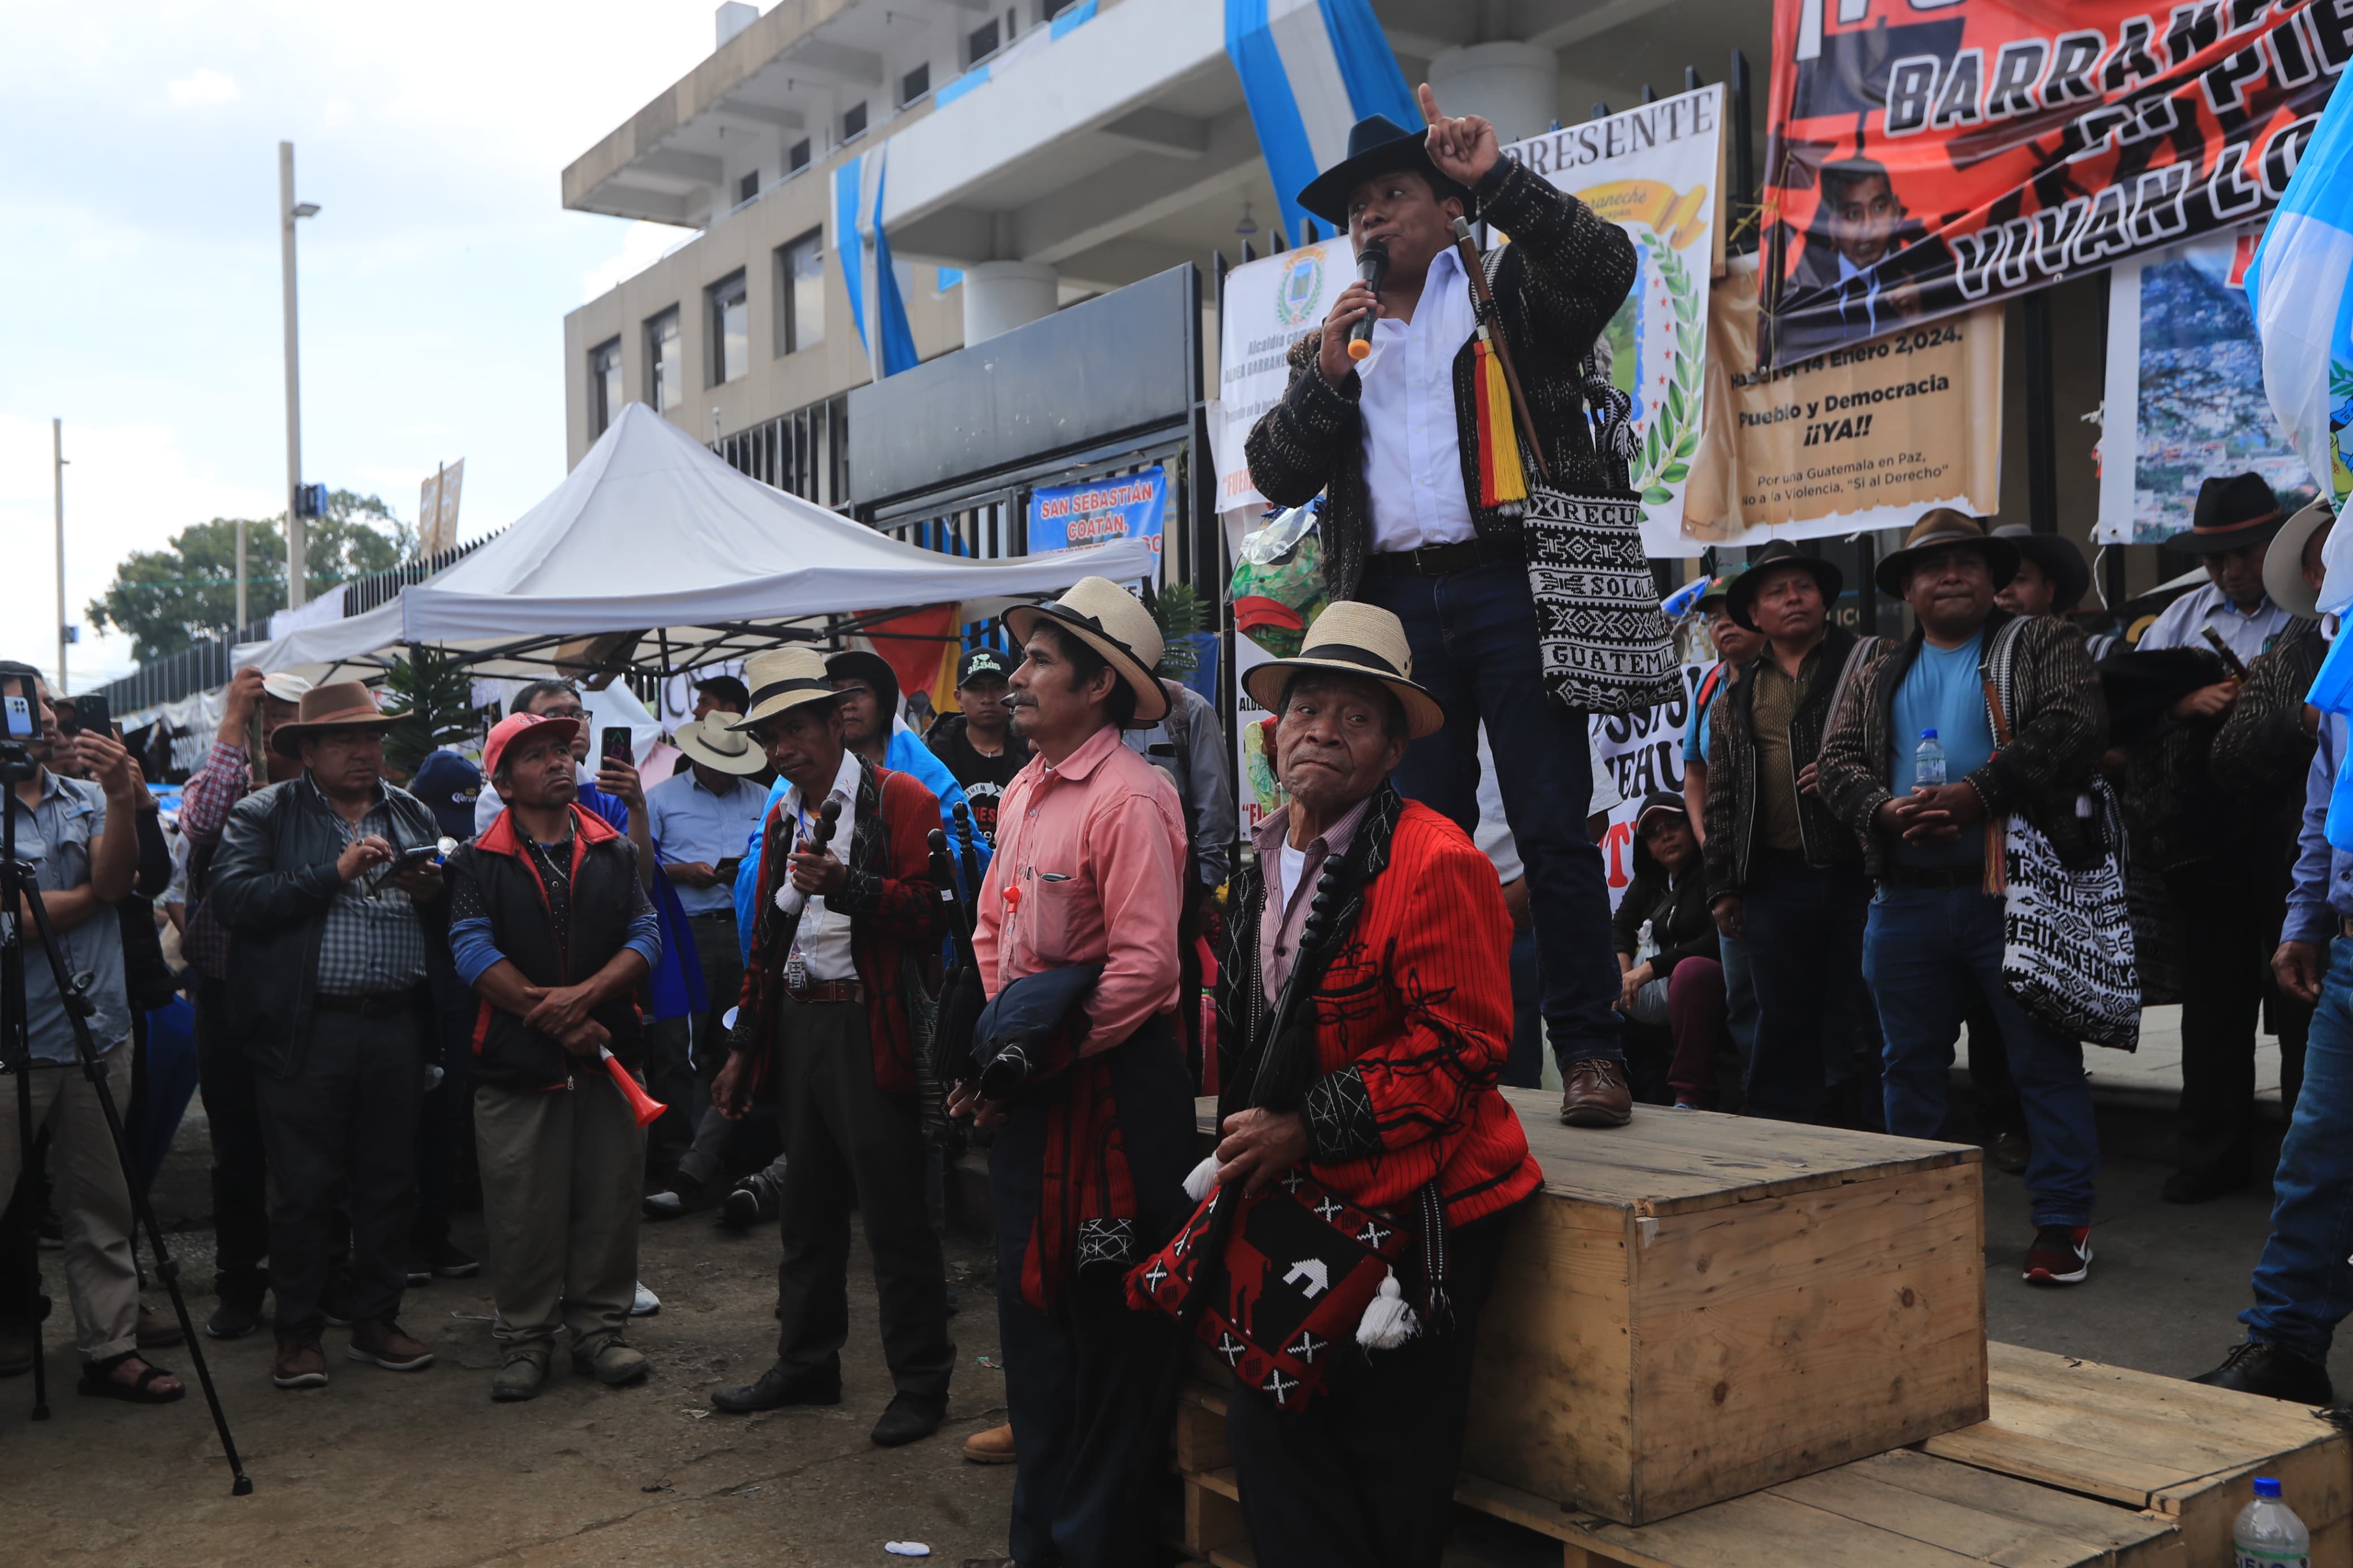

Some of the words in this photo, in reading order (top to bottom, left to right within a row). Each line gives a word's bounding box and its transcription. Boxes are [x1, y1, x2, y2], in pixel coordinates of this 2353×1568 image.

[1948, 160, 2193, 300] VIVAN
[1830, 343, 1889, 368] Enero
[1895, 325, 1963, 356] 2,024.
[1739, 402, 1802, 429] Pueblo
[1805, 400, 1819, 419] y
[1825, 373, 1950, 412] Democracia
[1742, 494, 1756, 507] No
[1760, 494, 1766, 504] a
[1771, 490, 1781, 503] la
[1869, 474, 1880, 487] al
[1757, 475, 1779, 488] Por
[1783, 471, 1803, 484] una
[1807, 459, 1874, 480] Guatemala
[1878, 456, 1894, 468] en
[1041, 497, 1070, 520] SAN
[1072, 480, 1153, 513] SEBASTIÁN
[1067, 511, 1129, 541] COATÁN,
